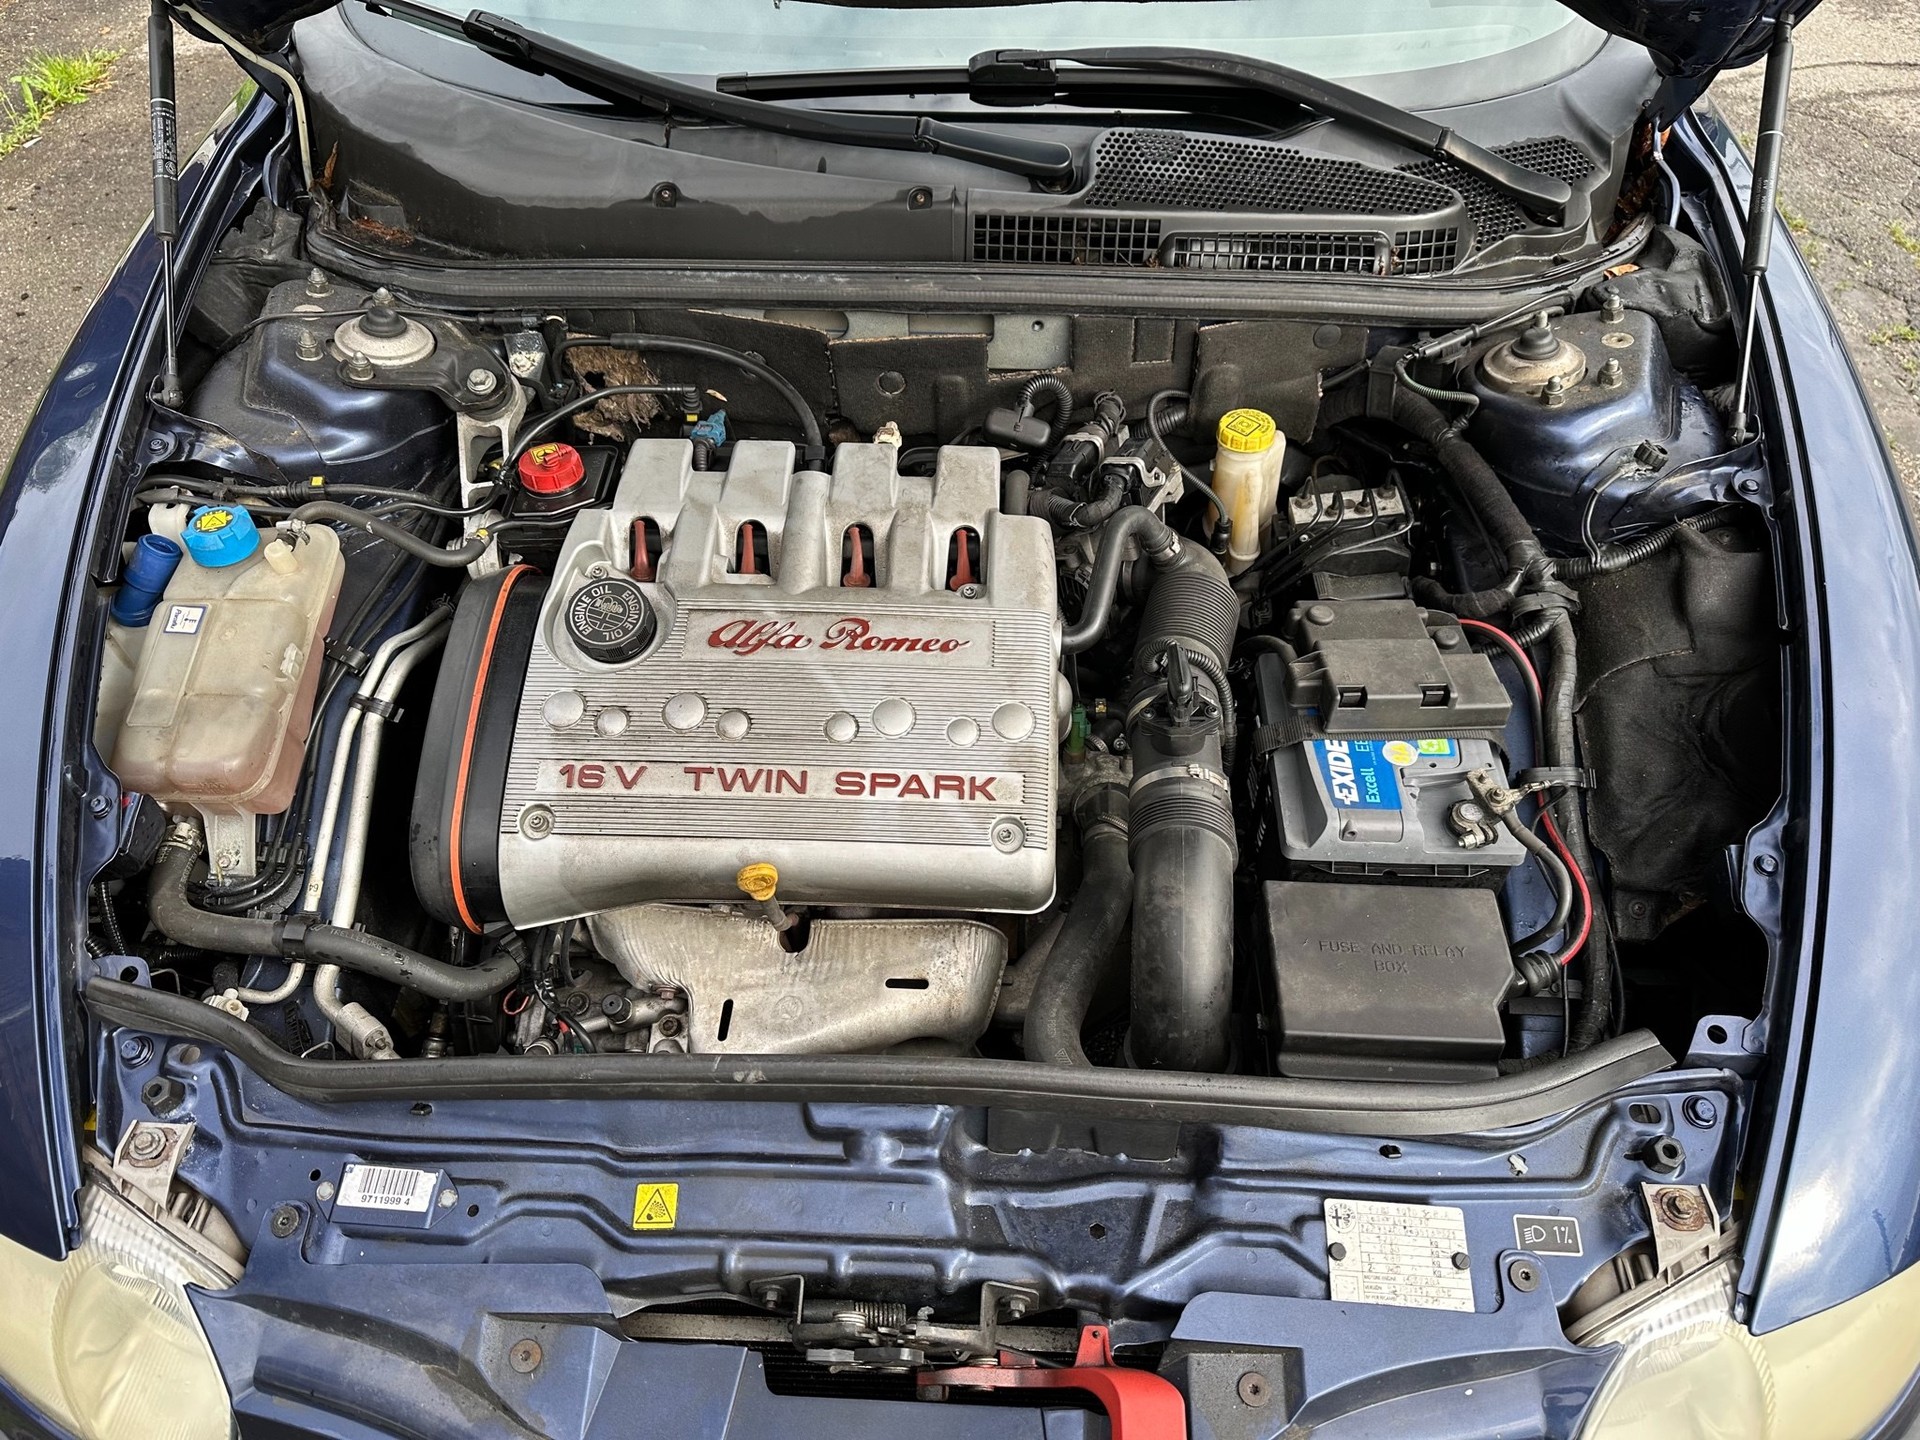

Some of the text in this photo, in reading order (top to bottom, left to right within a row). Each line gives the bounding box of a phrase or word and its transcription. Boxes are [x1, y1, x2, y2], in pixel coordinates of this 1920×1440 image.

[575, 585, 612, 636] ENGINE OIL
[603, 590, 639, 641] ENGINE OIL
[707, 617, 970, 656] Alfa Romeo
[684, 766, 808, 794] TWIN
[835, 771, 998, 801] SPARK
[1325, 740, 1360, 805] EXIDE
[1360, 767, 1381, 803] Excell
[329, 927, 383, 951] TRELLEBORG
[1318, 940, 1467, 958] FUSE AND RELAY
[1374, 959, 1409, 974] BOX
[360, 1194, 411, 1206] 9711999 4
[1552, 1225, 1573, 1244] 1%
